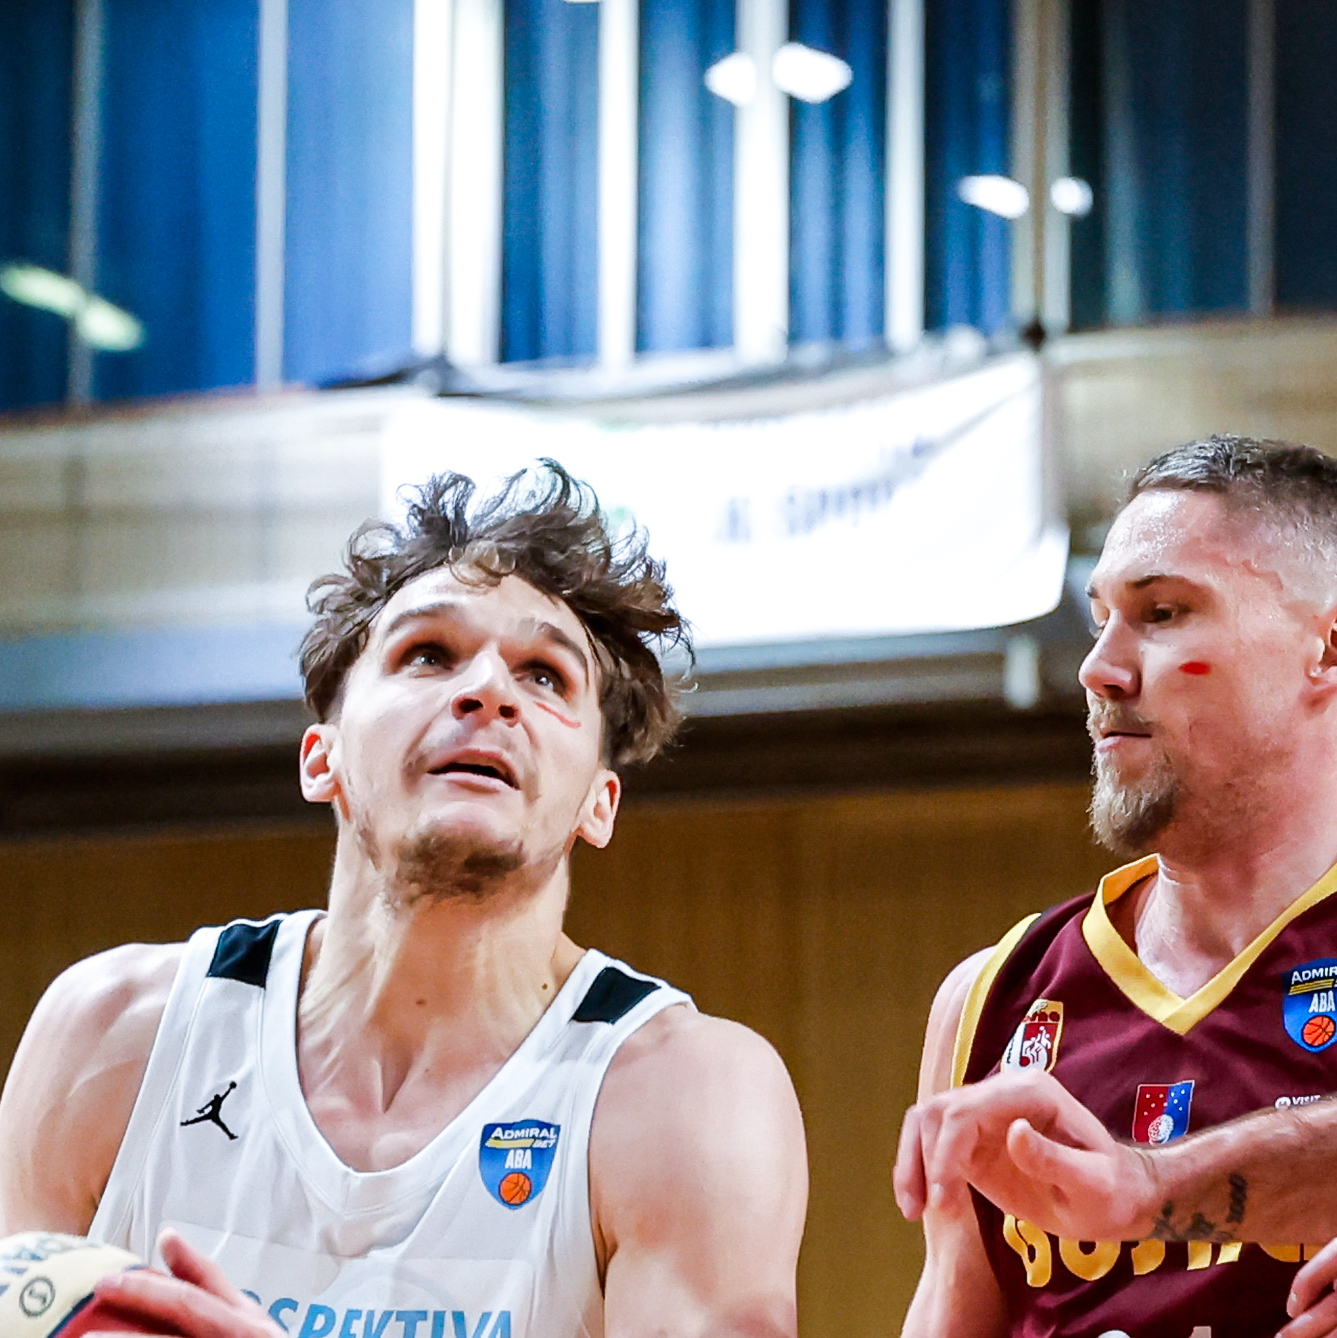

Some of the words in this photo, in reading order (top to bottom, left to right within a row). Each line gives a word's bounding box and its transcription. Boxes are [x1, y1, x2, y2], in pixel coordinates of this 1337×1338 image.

[1308, 990, 1336, 1013] ABA
[490, 1127, 558, 1140] ADMIRAL
[504, 1149, 533, 1170] ABA
